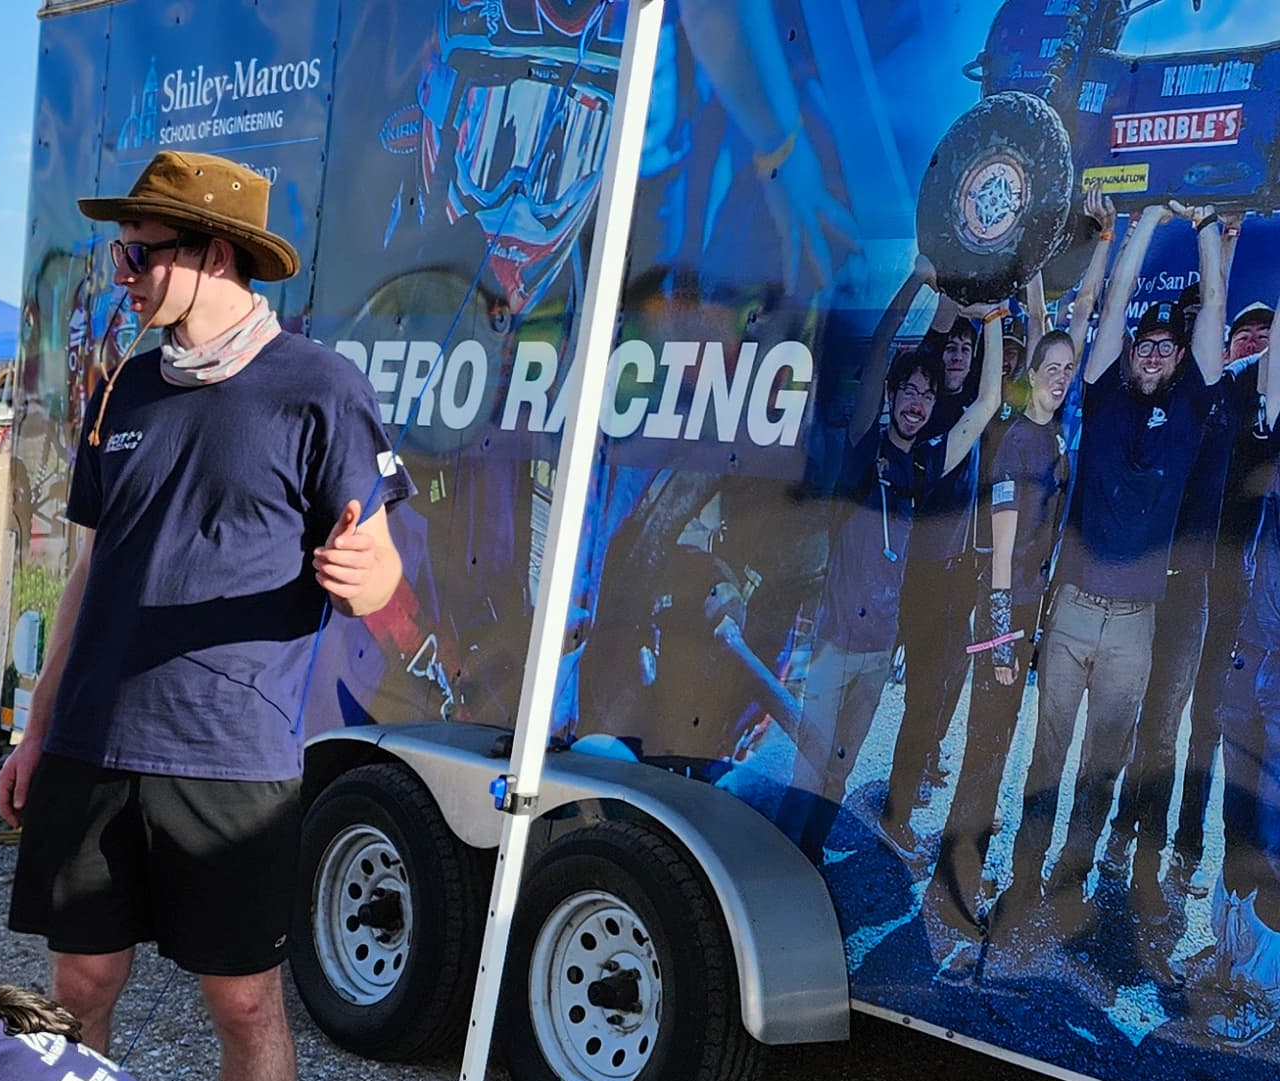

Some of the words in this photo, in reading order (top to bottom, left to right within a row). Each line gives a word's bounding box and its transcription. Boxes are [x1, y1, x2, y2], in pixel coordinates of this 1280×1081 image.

[161, 58, 320, 117] Shiley-Marcos
[159, 121, 197, 145] SCHOOL
[198, 120, 211, 139] OF
[212, 110, 283, 135] ENGINEERING
[1114, 110, 1239, 144] TERRIBLE'S
[1159, 271, 1184, 290] San
